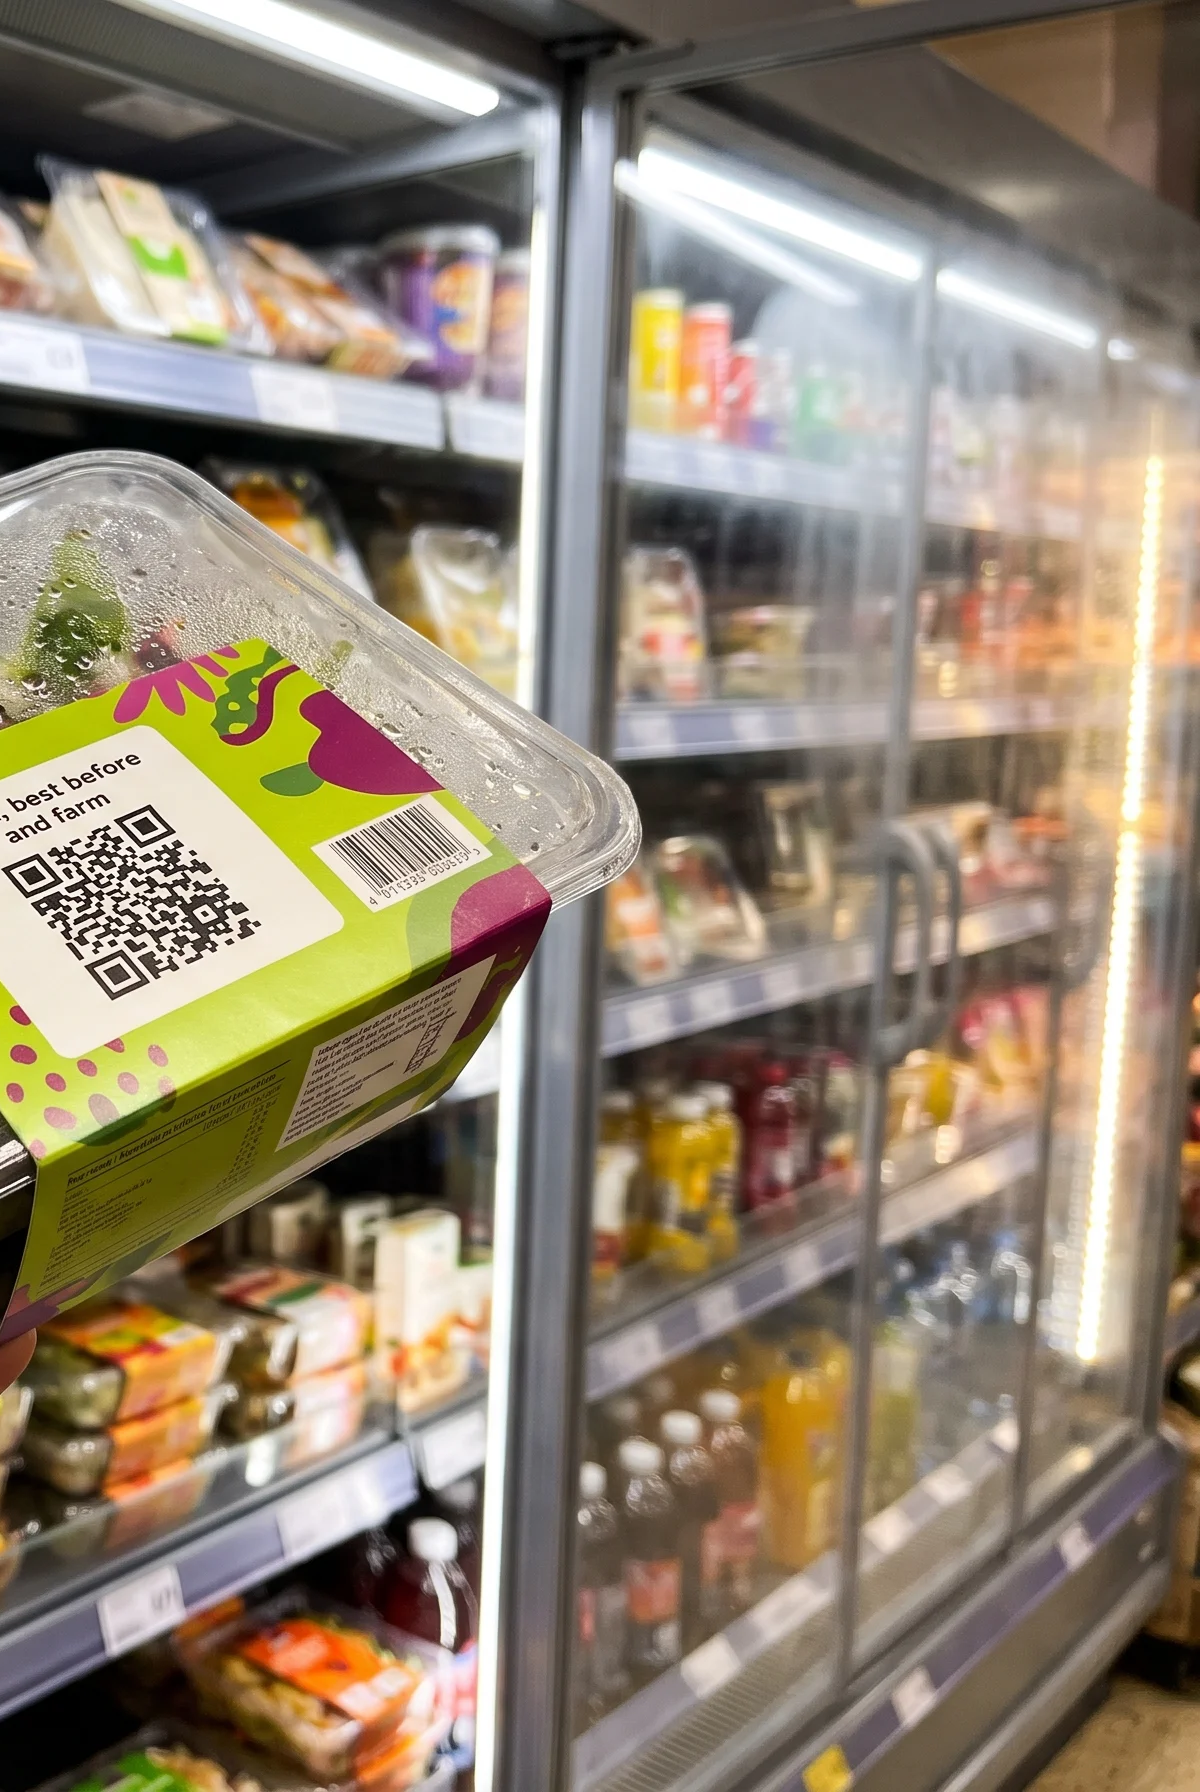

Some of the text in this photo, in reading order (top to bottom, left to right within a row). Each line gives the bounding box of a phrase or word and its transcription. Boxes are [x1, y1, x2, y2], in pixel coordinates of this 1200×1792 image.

[6, 783, 65, 813] best
[61, 753, 142, 790] before
[4, 792, 112, 844] and farm
